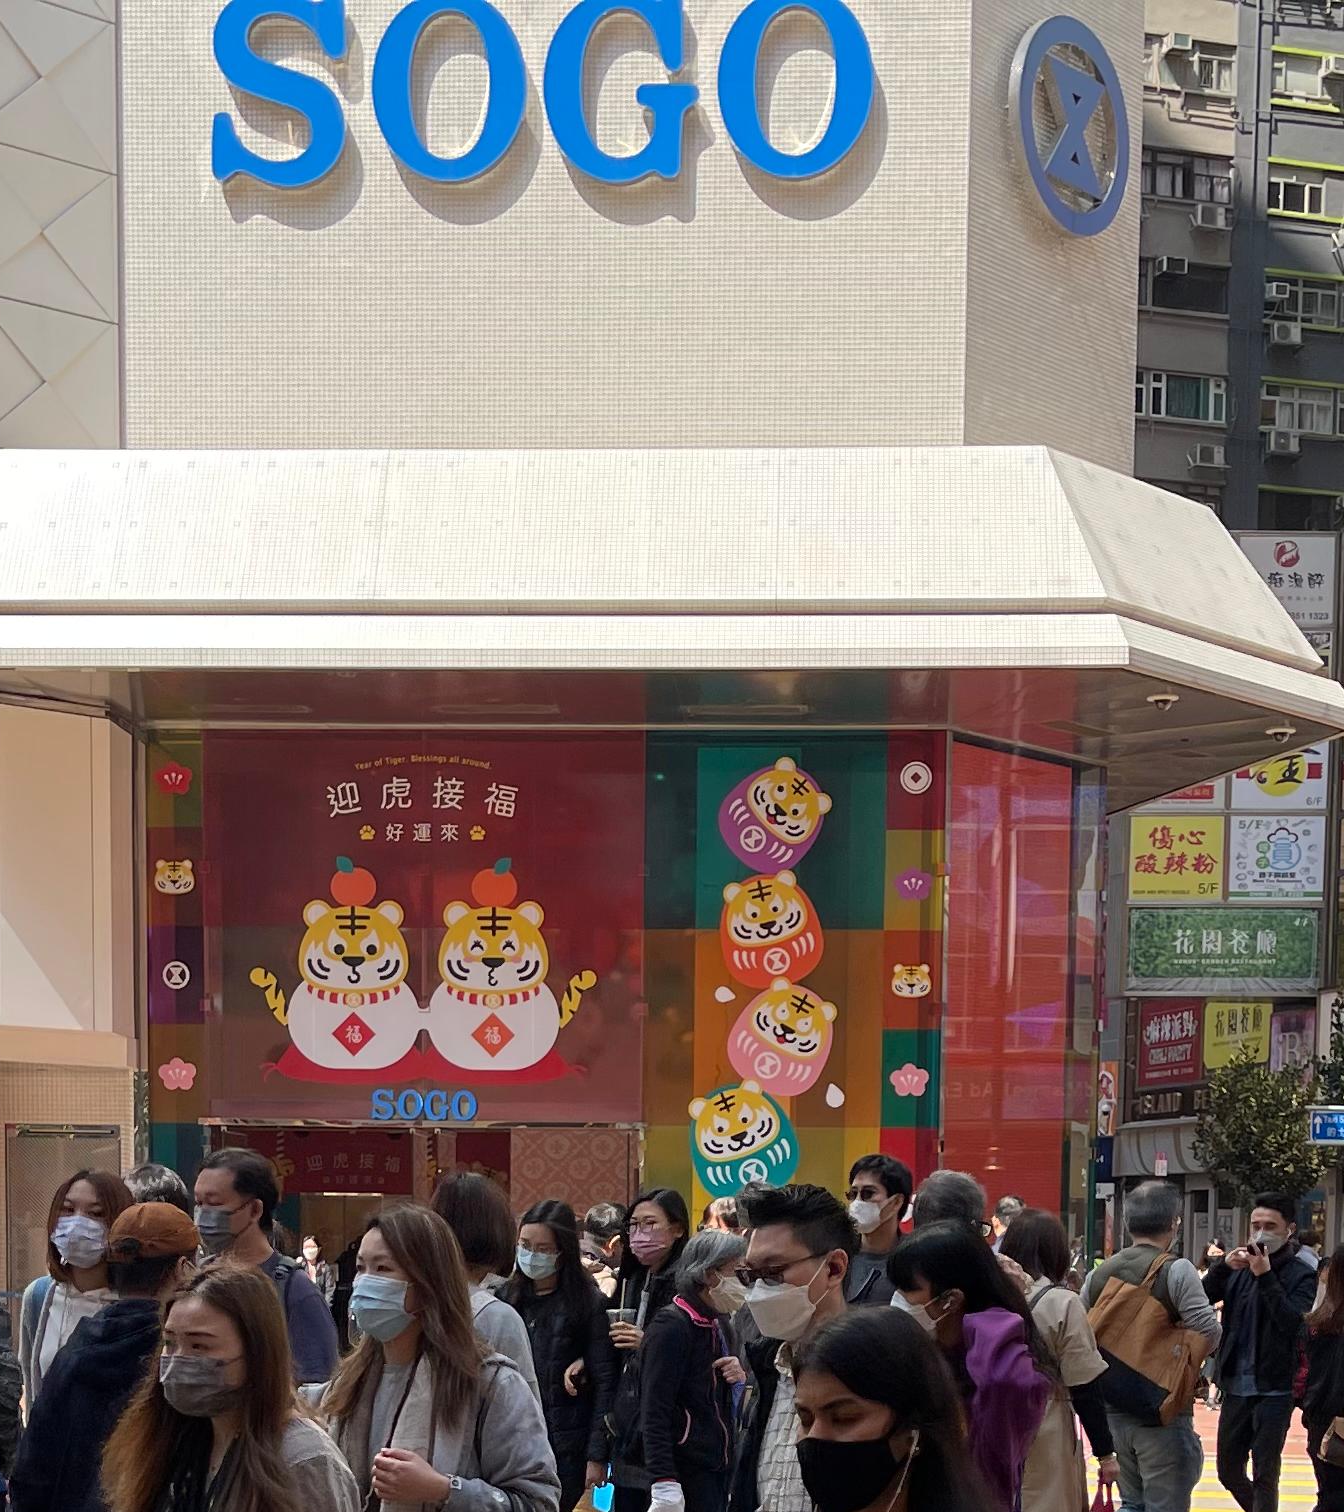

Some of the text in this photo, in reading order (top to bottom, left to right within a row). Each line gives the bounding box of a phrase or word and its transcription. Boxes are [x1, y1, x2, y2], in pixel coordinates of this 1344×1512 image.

[211, 0, 875, 187] SOGO
[354, 761, 372, 771] Year
[374, 755, 383, 767] of
[411, 754, 447, 764] Blessings
[449, 755, 460, 764] all
[326, 775, 519, 818] 迎虎接福
[1305, 796, 1323, 807] 6/F
[385, 823, 459, 842] 好運來
[1237, 819, 1263, 830] 5/F
[1148, 825, 1206, 850] 傷心
[1134, 852, 1219, 876] 酸辣粉
[1197, 882, 1220, 896] 5/F
[345, 1024, 363, 1044] 福
[484, 1026, 502, 1045] 福
[371, 1088, 479, 1121] SOGO
[1323, 1115, 1339, 1124] Taxi
[306, 1151, 402, 1174] 迎虎接福
